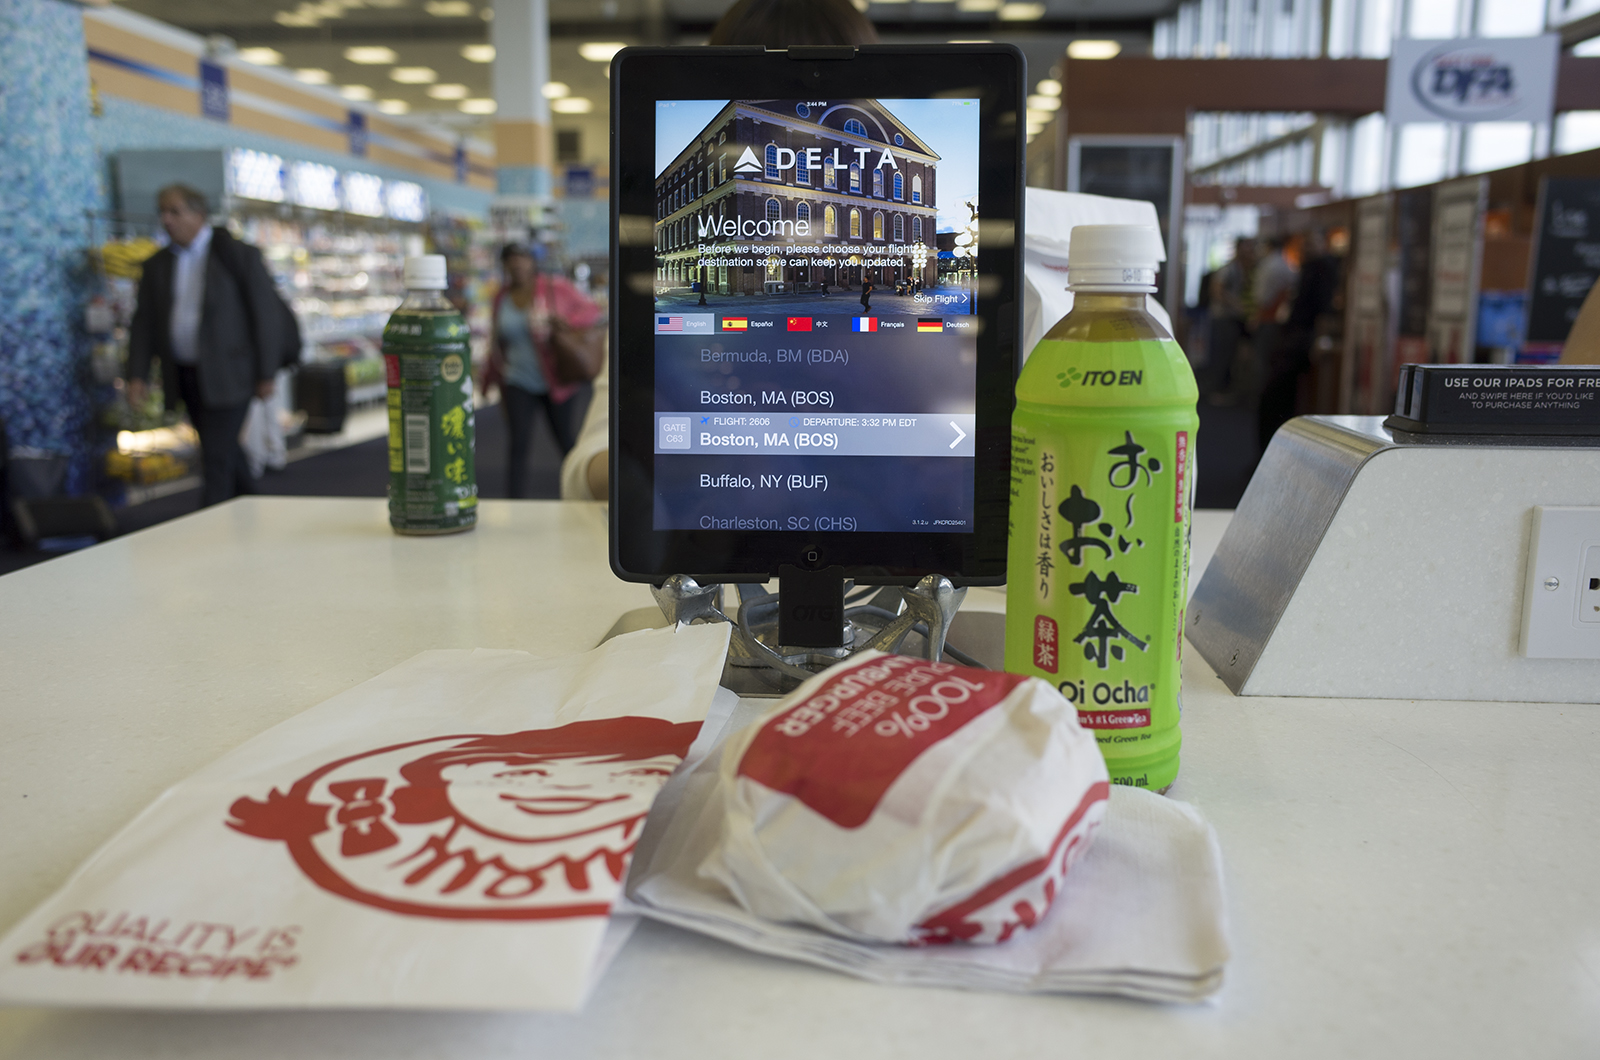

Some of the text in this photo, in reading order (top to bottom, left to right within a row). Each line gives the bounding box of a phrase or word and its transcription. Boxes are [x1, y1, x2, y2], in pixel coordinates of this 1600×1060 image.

[776, 147, 899, 170] DELTA
[697, 214, 810, 237] Welcome
[698, 243, 914, 257] Before we begin, please choose your flight
[697, 257, 907, 269] destination so we can keep you updated.
[913, 294, 958, 305] Skip Flight
[686, 320, 707, 328] English
[750, 320, 774, 329] Español
[815, 320, 829, 328] 中文
[880, 321, 905, 329] Français
[946, 321, 970, 329] Deutsch
[700, 348, 849, 366] Bermuda, BM (BDA)
[1081, 370, 1143, 386] ITO EN
[1444, 377, 1470, 388] USE
[1472, 377, 1501, 388] OUR
[1504, 377, 1544, 388] IPADS
[1547, 377, 1575, 388] FOR
[700, 390, 835, 408] Boston, MA (BOS)
[1458, 392, 1479, 400] AND
[1480, 392, 1508, 400] SWIPE
[1510, 392, 1534, 400] HERE
[1535, 392, 1544, 400] IF
[1545, 392, 1573, 400] YOU'D
[1471, 401, 1581, 409] TO PURCHASE ANYTHING
[663, 423, 687, 432] GATE
[713, 417, 771, 426] FLIGHT: 2606
[803, 417, 917, 427] DEPARTURE: 3:32 PM EDT
[666, 434, 684, 443] C63
[700, 432, 839, 450] Boston, MA (BOS)
[700, 473, 828, 491] Buffalo, NY (BUF)
[699, 515, 858, 532] Charleston, SC (CHS)
[1036, 452, 1055, 600] おいしさは香り
[1058, 484, 1149, 669] お茶
[1037, 619, 1055, 668] 緑茶
[1058, 679, 1149, 705] Oi Ocha
[874, 675, 985, 739] 100%
[832, 689, 900, 739] BEEF
[1108, 714, 1133, 725] Green
[1134, 713, 1147, 724] Tea
[1113, 735, 1138, 744] Green
[1140, 733, 1152, 741] Tea
[1113, 776, 1133, 787] 500
[47, 910, 303, 954] QUALITY IS
[15, 940, 118, 972] OUR
